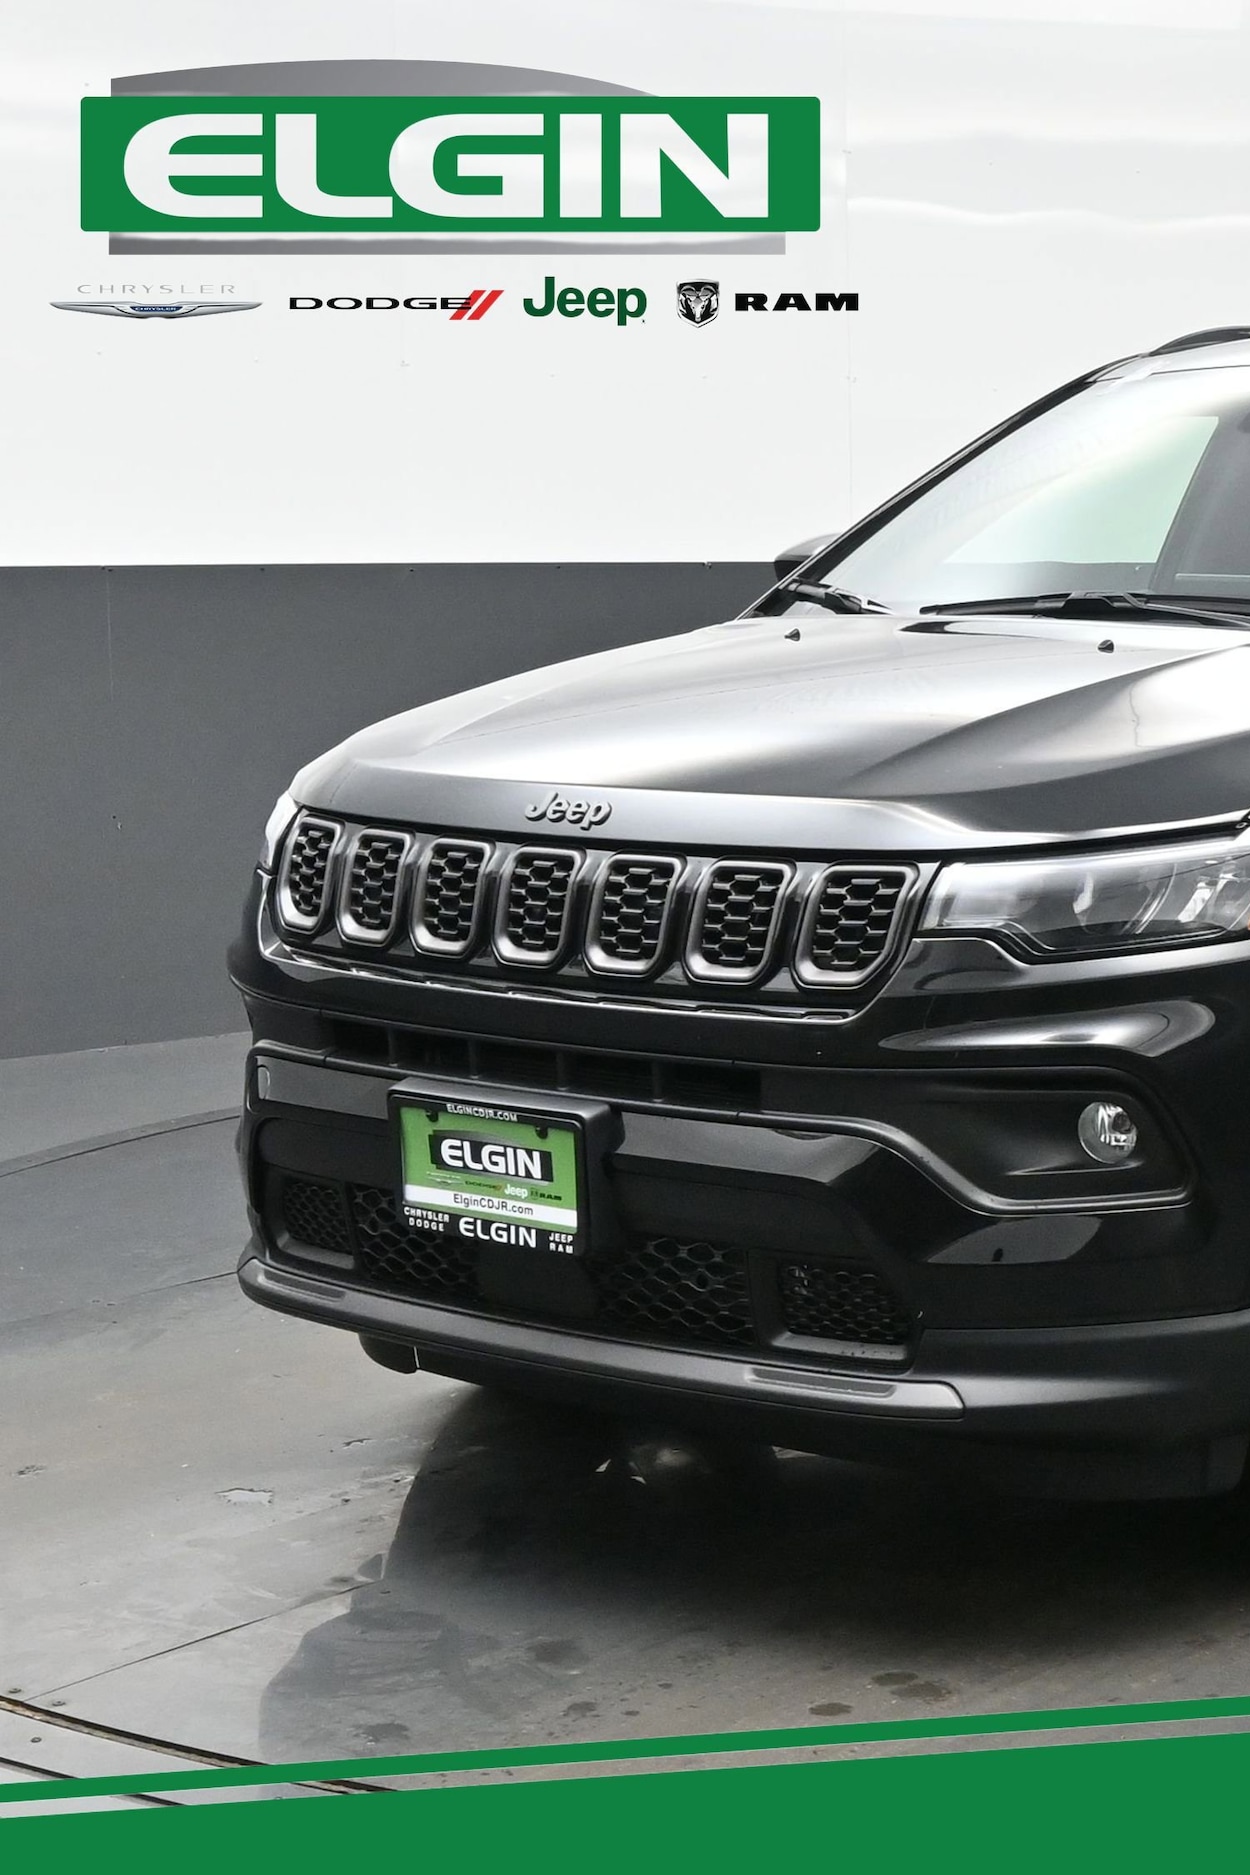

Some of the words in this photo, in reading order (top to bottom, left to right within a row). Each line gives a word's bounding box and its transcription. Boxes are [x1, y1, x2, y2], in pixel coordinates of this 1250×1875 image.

[525, 792, 612, 831] Jeep
[440, 1138, 542, 1180] ELGIN
[504, 1183, 528, 1199] Jeep
[453, 1193, 534, 1216] ElginCDJR.com
[403, 1206, 450, 1223] CHRYSLER
[408, 1217, 444, 1232] DODGE
[458, 1217, 537, 1248] ELGIN
[549, 1232, 573, 1243] JEEP
[549, 1243, 574, 1254] RAM
